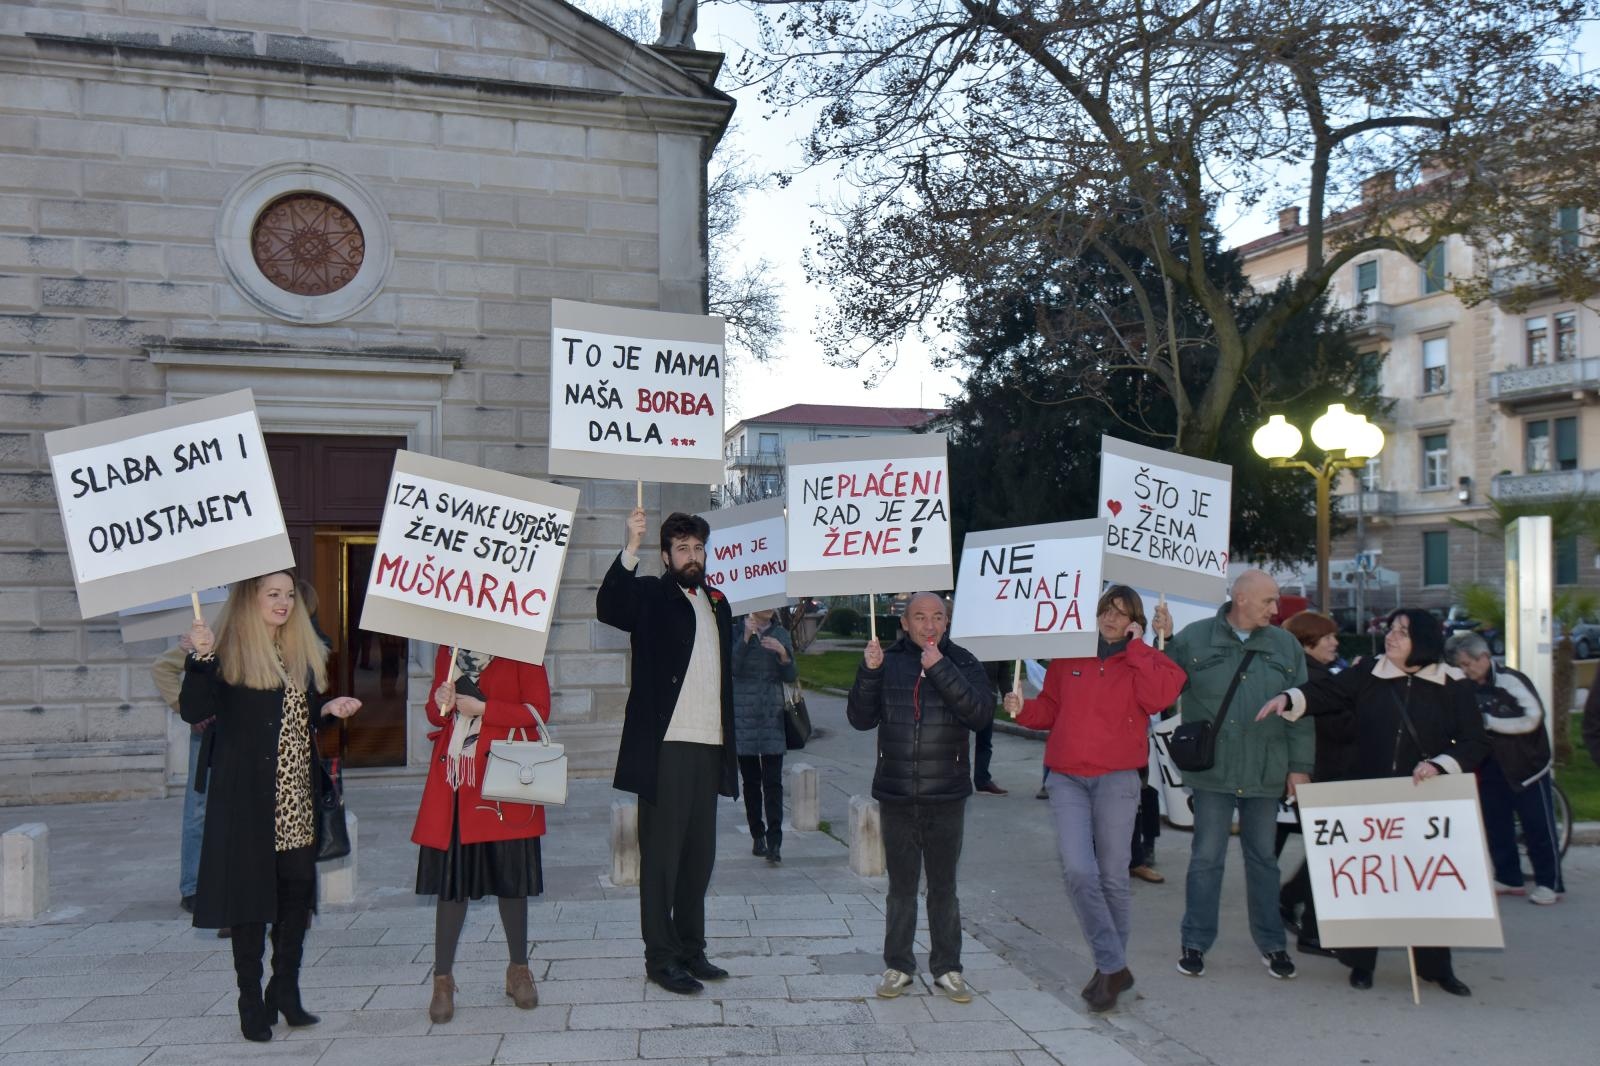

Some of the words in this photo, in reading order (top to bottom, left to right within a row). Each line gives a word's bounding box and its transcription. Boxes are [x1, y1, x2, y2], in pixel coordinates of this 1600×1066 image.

[562, 337, 602, 368] TO
[612, 345, 641, 371] JE
[654, 349, 720, 379] NAMA
[565, 379, 624, 410] NAŠA
[635, 388, 715, 417] BORBA
[71, 455, 162, 499] SLABA
[173, 437, 223, 473] SAM
[237, 433, 248, 459] I
[803, 462, 942, 501] NEPLAĆENI
[1134, 466, 1178, 509] ŠTO
[1188, 489, 1212, 518] JE
[88, 490, 252, 554] ODUSTAJEM
[393, 483, 429, 510] IZA
[435, 492, 501, 529] SVAKE
[502, 509, 570, 547] USPJEŠNE
[813, 504, 861, 527] RAD
[875, 499, 906, 523] JE
[910, 498, 947, 522] ZA
[1136, 504, 1197, 543] ŽENA
[404, 515, 469, 553] ŽENE
[714, 542, 743, 561] VAM
[750, 536, 768, 553] JE
[1107, 524, 1144, 553] BEZ
[1148, 534, 1229, 575] BRKOVA?
[705, 571, 725, 587] KO
[729, 568, 739, 582] U
[744, 559, 787, 580] BRAKU
[979, 543, 1036, 577] NE
[376, 552, 547, 616] MUŠKARAC
[995, 570, 1081, 600] ZNAČI
[1033, 599, 1082, 632] DA
[1314, 819, 1349, 846] ZA
[1359, 817, 1405, 843] SVE
[1424, 816, 1450, 840] SI
[1329, 854, 1467, 898] KRIVA
